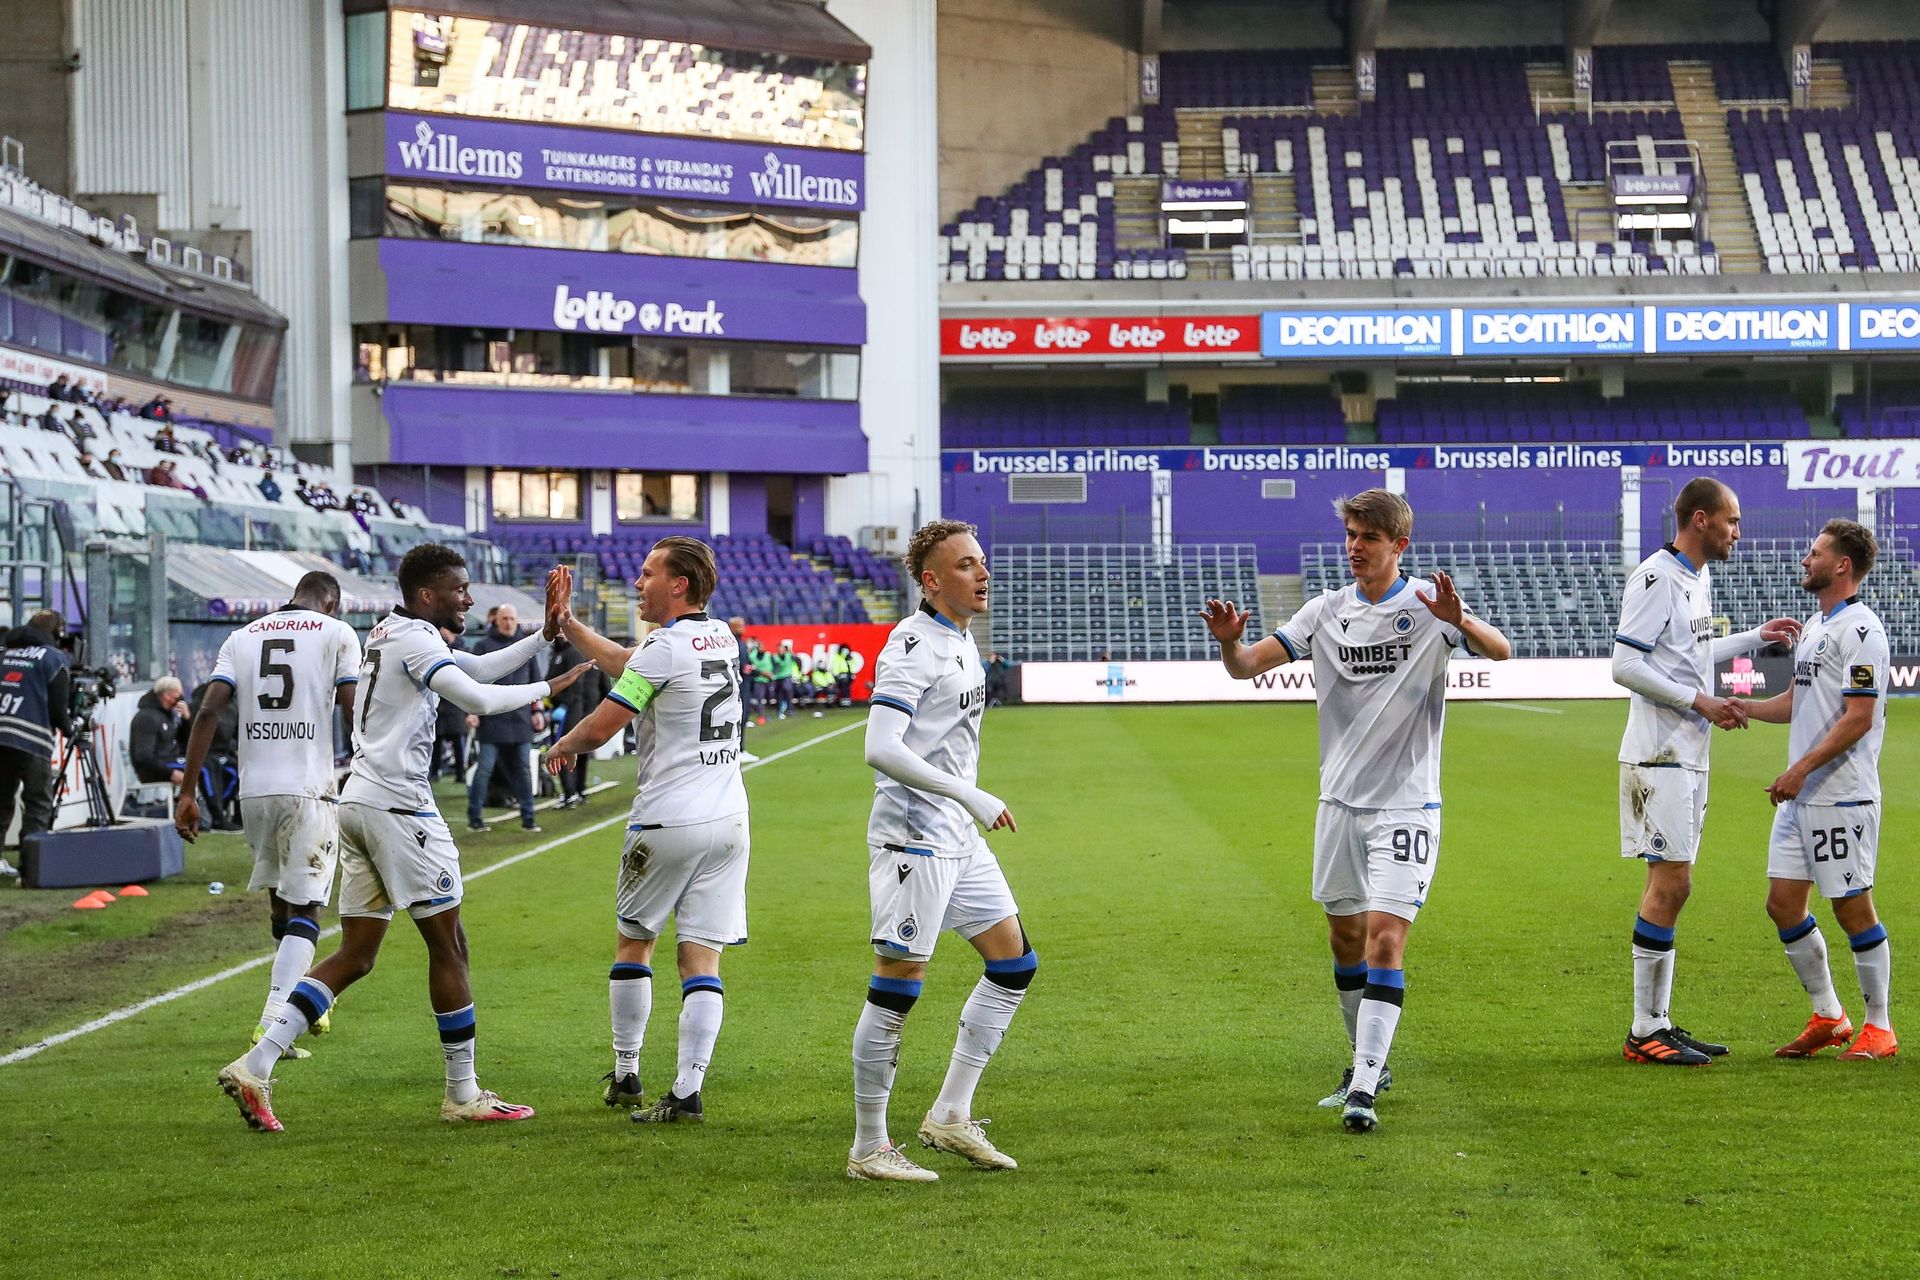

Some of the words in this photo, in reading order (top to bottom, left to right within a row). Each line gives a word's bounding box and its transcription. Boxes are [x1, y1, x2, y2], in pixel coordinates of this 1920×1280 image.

[398, 120, 523, 179] willems
[750, 151, 858, 205] willems
[664, 300, 725, 335] Park
[1279, 314, 1442, 345] DECATHLON
[1471, 312, 1634, 344] DECATHLON
[1665, 310, 1828, 341] DECATHLON
[973, 450, 1069, 473] brussels
[1073, 448, 1160, 472] airlines
[1203, 448, 1299, 471] brussels
[1304, 447, 1390, 470] airlines
[1435, 445, 1531, 468] brussels
[1535, 444, 1622, 468] airlines
[1667, 442, 1763, 466] brussels
[1801, 447, 1904, 482] Tout
[249, 620, 323, 633] CANDRIAM
[1338, 644, 1412, 663] UNIBET
[258, 639, 295, 712] 5
[1392, 829, 1430, 865] 90
[1812, 827, 1849, 863] 26
